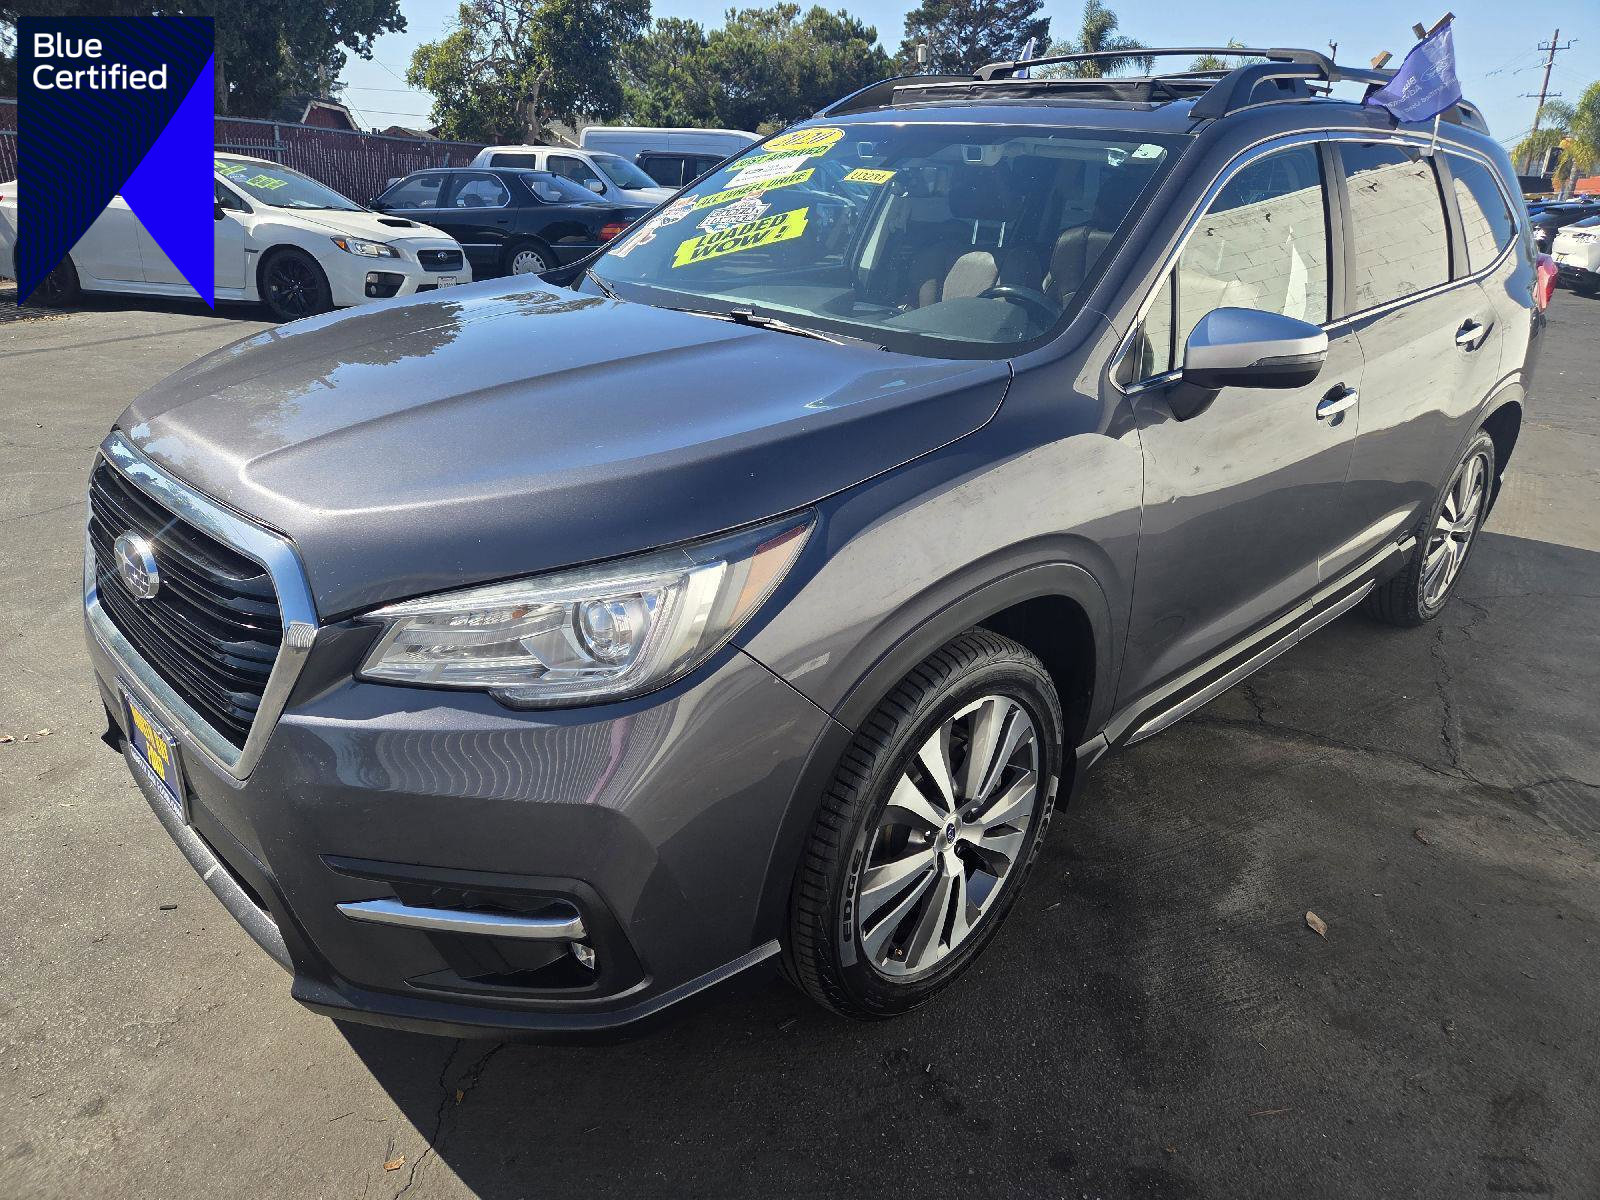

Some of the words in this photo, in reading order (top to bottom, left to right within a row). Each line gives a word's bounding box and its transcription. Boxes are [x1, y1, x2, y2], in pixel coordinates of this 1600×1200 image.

[766, 171, 807, 188] DRIVE
[690, 231, 770, 259] WOW
[696, 213, 789, 247] LOADED
[842, 848, 863, 943] EDGE
